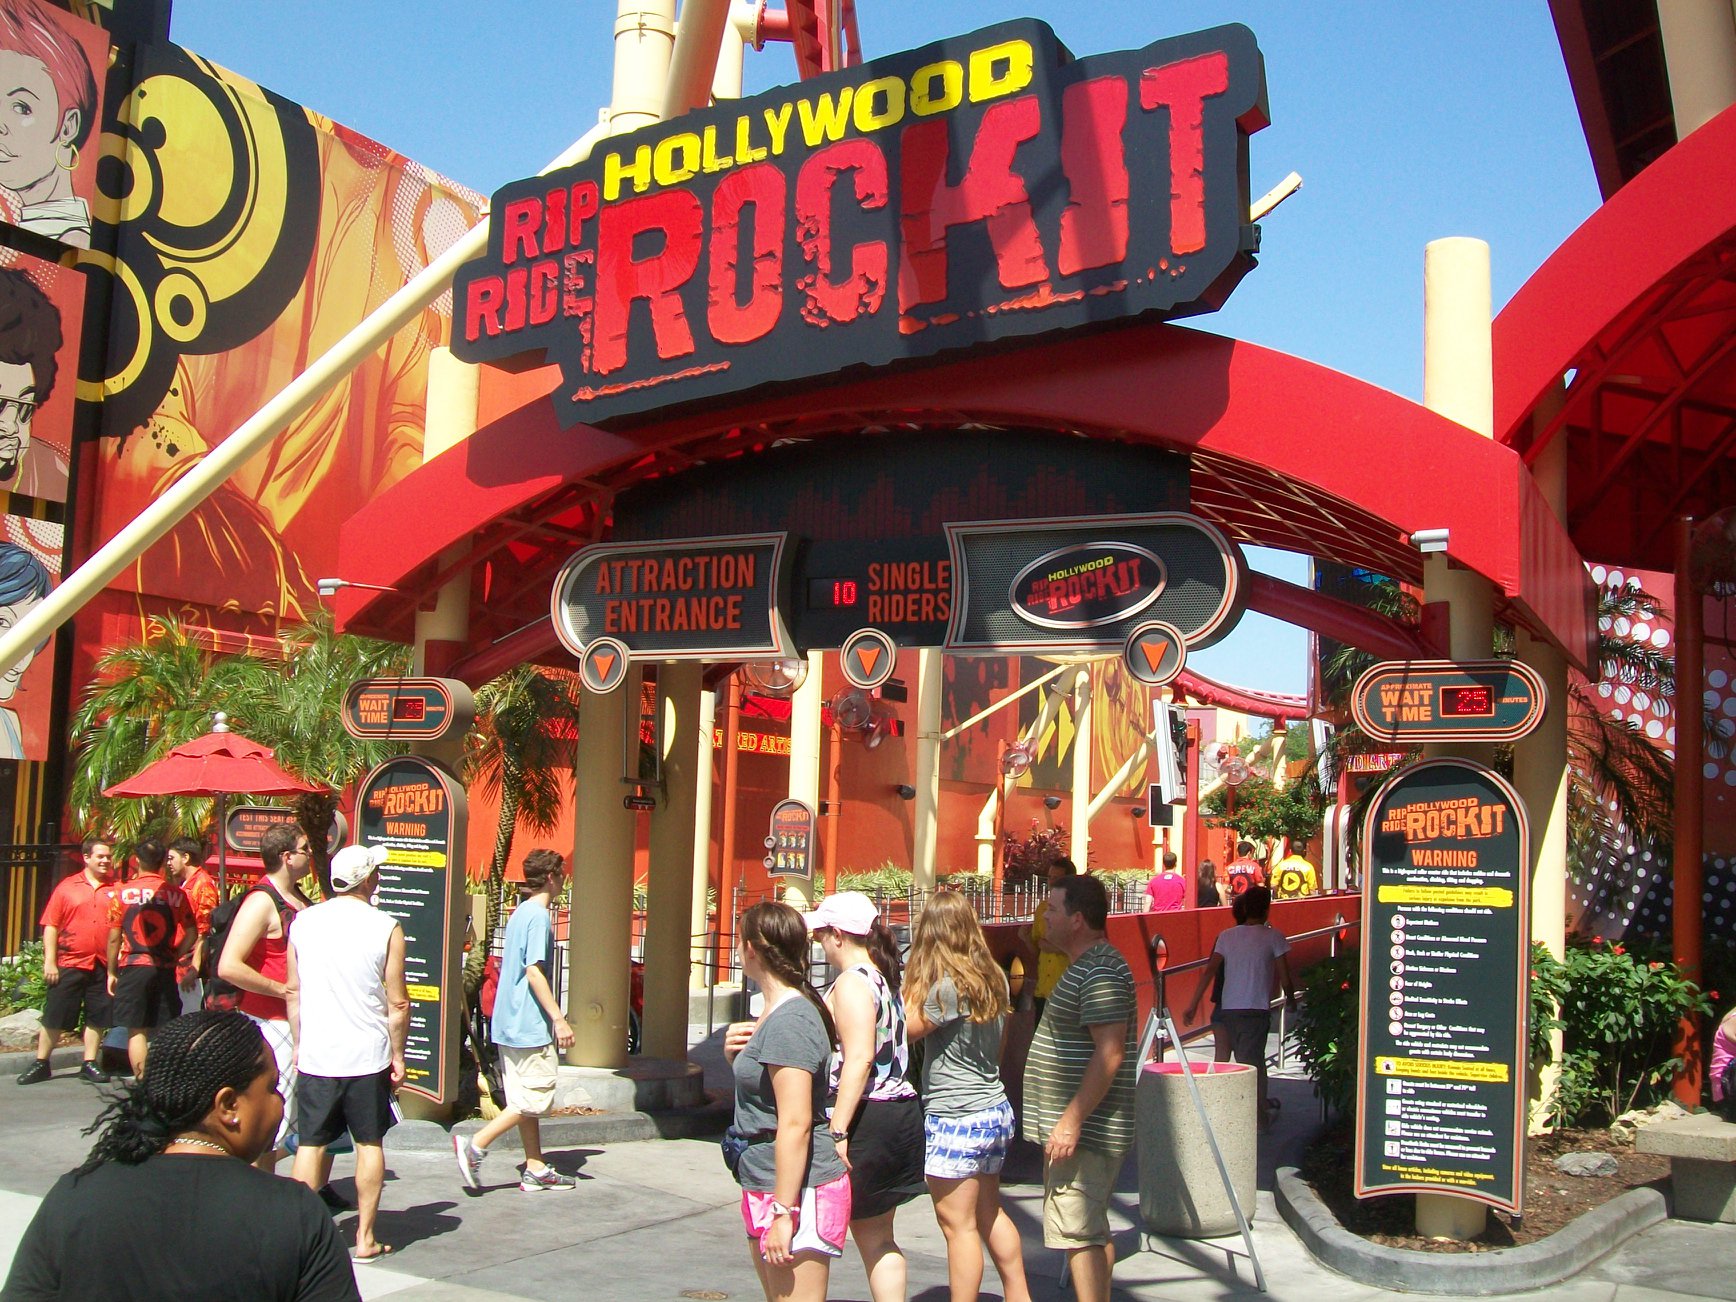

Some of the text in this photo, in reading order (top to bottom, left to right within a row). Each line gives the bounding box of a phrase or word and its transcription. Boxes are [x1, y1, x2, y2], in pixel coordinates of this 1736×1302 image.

[604, 40, 1034, 201] HOLLYWOOD
[503, 180, 599, 264] RIP
[592, 50, 1229, 376] ROCKIT
[465, 249, 594, 342] RIDE
[595, 554, 755, 595] ATTRACTION
[867, 560, 950, 591] SINGLE
[1048, 556, 1114, 582] HOLLYWOOD
[833, 581, 857, 606] 10
[1048, 558, 1141, 610] ROCKIT
[605, 595, 743, 633] ENTRANCE
[868, 592, 950, 623] RIDERS
[360, 699, 389, 711] WAIT
[1380, 690, 1434, 706] WAIT
[360, 711, 388, 724] TIME
[1381, 706, 1433, 722] TME
[384, 788, 444, 815] ROCKIT
[1407, 797, 1479, 813] HOLLYWOOD
[1381, 820, 1407, 832] RIDE
[1388, 808, 1407, 821] RIP
[1406, 804, 1507, 840] ROCKIT
[386, 821, 426, 837] WARNING
[1228, 865, 1255, 875] CREW
[1411, 849, 1478, 868] WARNING
[122, 887, 183, 908] CREW
